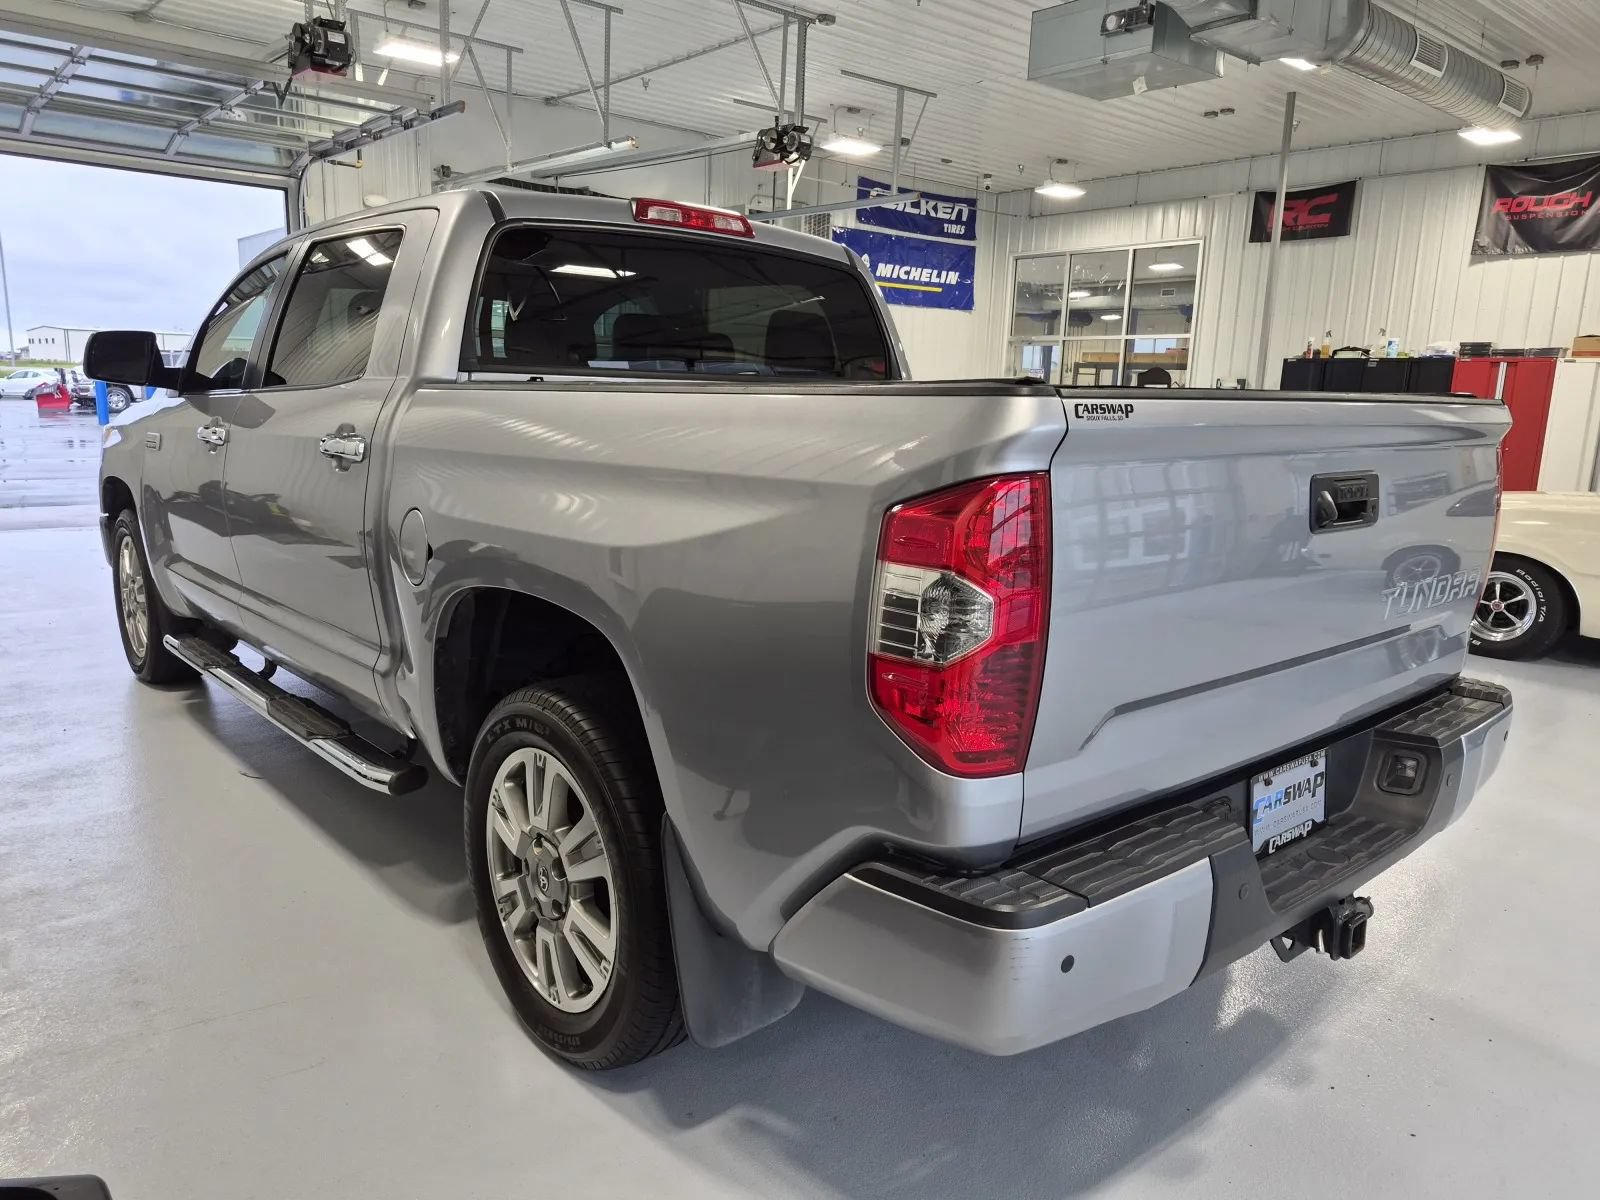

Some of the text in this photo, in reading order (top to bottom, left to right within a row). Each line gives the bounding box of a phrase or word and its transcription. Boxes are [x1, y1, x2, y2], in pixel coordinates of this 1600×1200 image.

[880, 197, 969, 221] ALKEN
[1491, 191, 1593, 214] ROUGH
[943, 223, 966, 235] TIRES
[875, 263, 960, 285] MICHELIN
[1074, 403, 1134, 419] CARSWAP
[1381, 568, 1481, 620] TUNDRA
[1252, 771, 1325, 826] CARSWAP
[1268, 820, 1313, 855] CARSWAP
